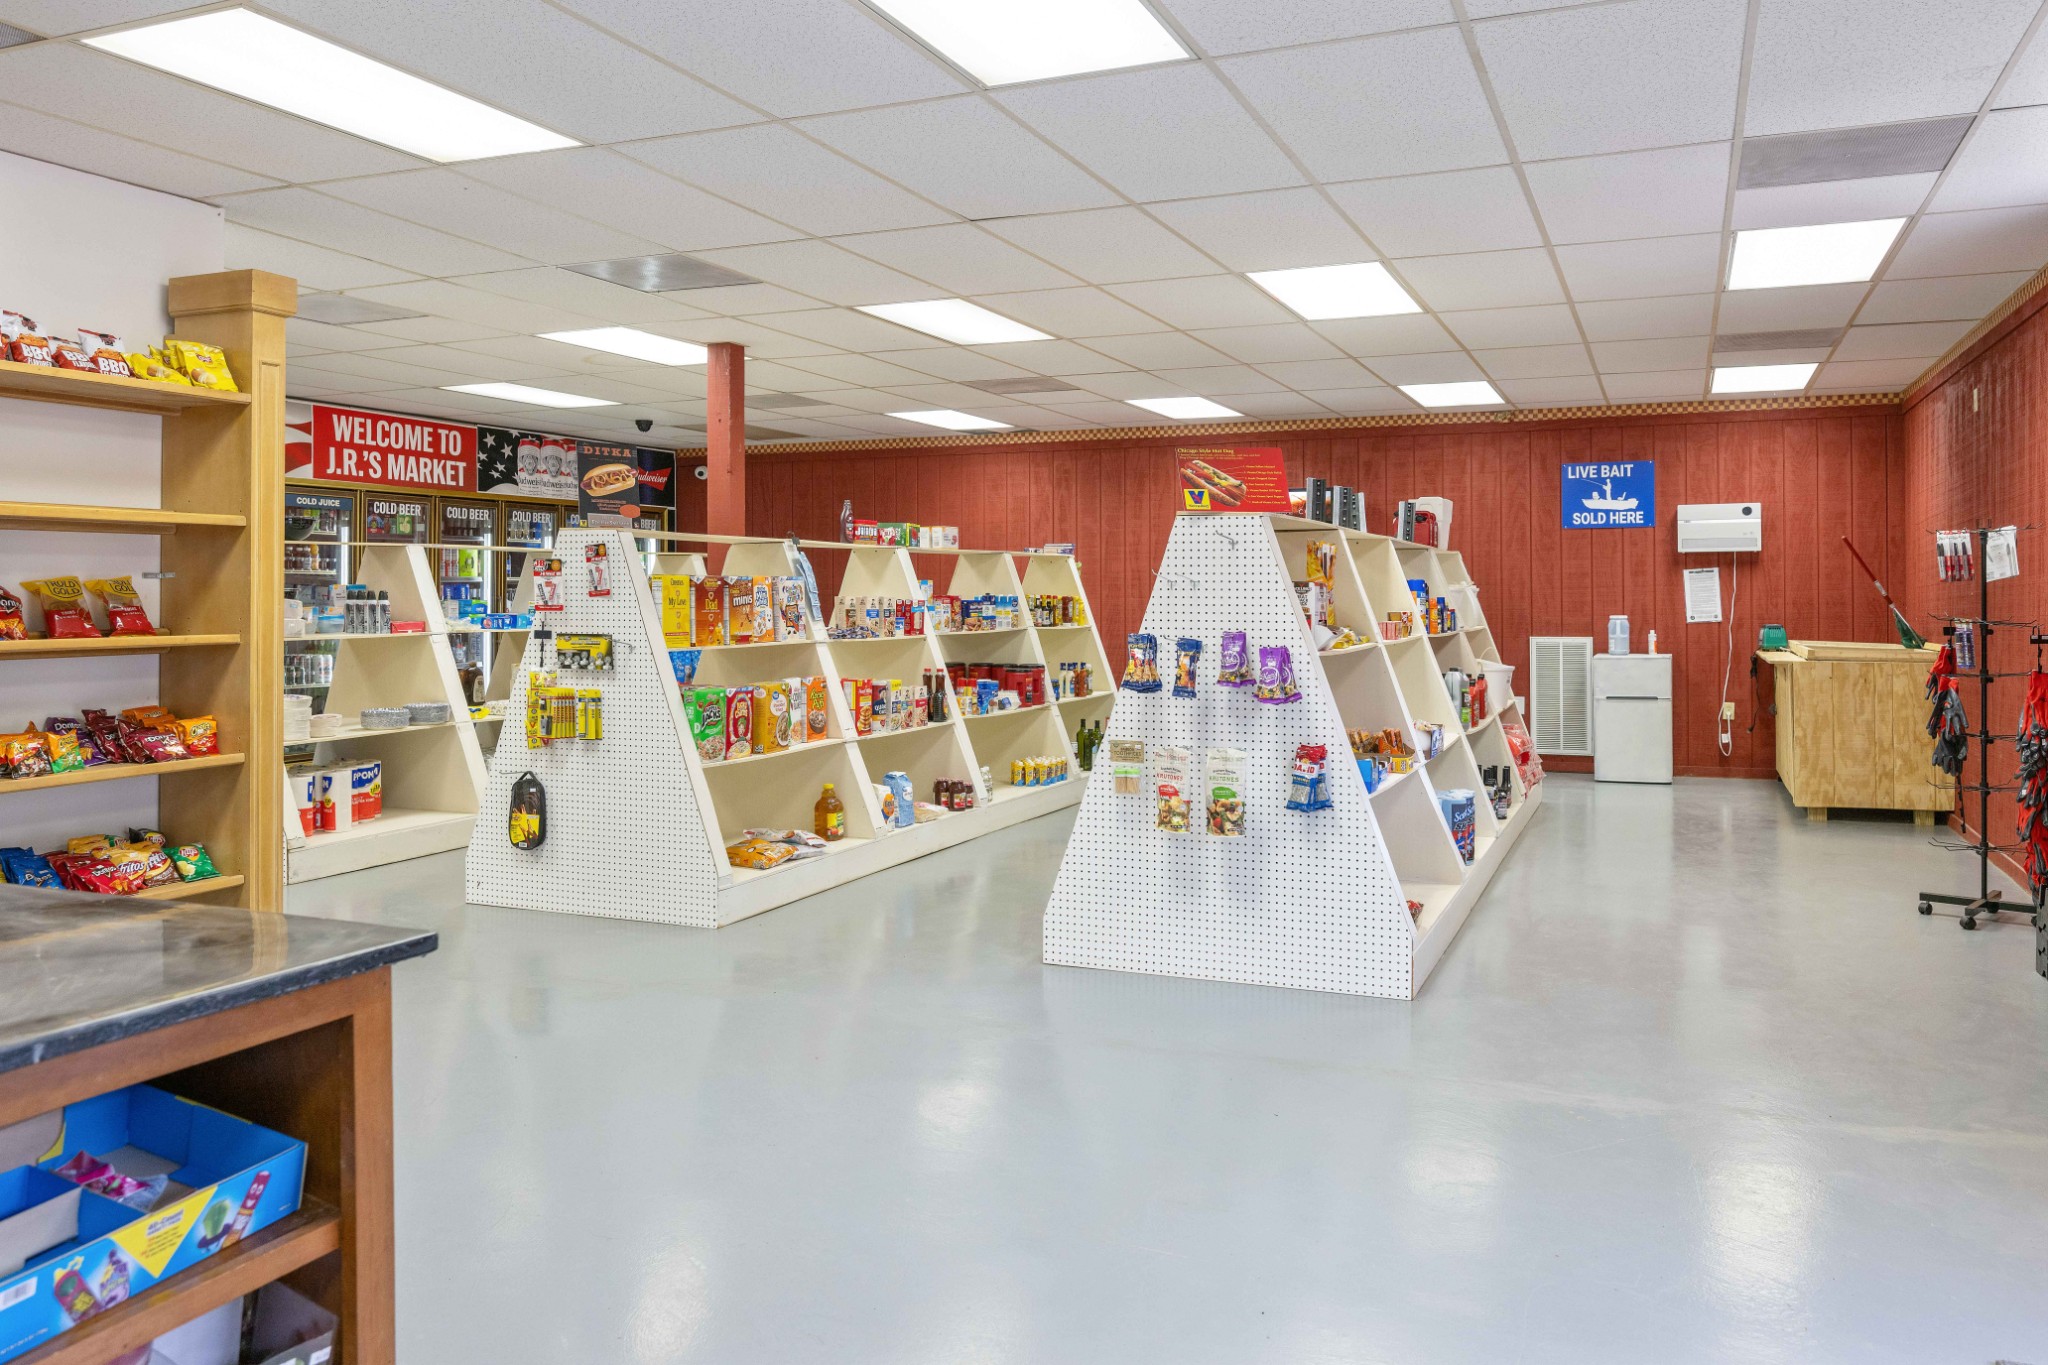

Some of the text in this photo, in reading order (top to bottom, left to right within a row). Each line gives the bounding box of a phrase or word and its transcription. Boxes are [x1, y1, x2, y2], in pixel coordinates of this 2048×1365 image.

[21, 342, 51, 361] BBQ
[98, 357, 130, 376] BBQ
[331, 413, 462, 457] WELCOME TO
[583, 444, 632, 458] DITKA
[387, 453, 467, 487] MARKET
[636, 469, 668, 484] udweiser
[1567, 464, 1634, 479] LIVE BAIT
[296, 497, 340, 507] COLD JUICE
[373, 501, 421, 516] COLD BEER
[446, 506, 489, 521] COLD BEER
[512, 510, 551, 524] COLD BEER
[1572, 511, 1644, 525] SOLD HERE
[570, 514, 580, 525] CO
[640, 518, 657, 531] BEER
[53, 587, 80, 595] GOLD
[732, 595, 753, 606] minis
[118, 861, 145, 875] Fritos
